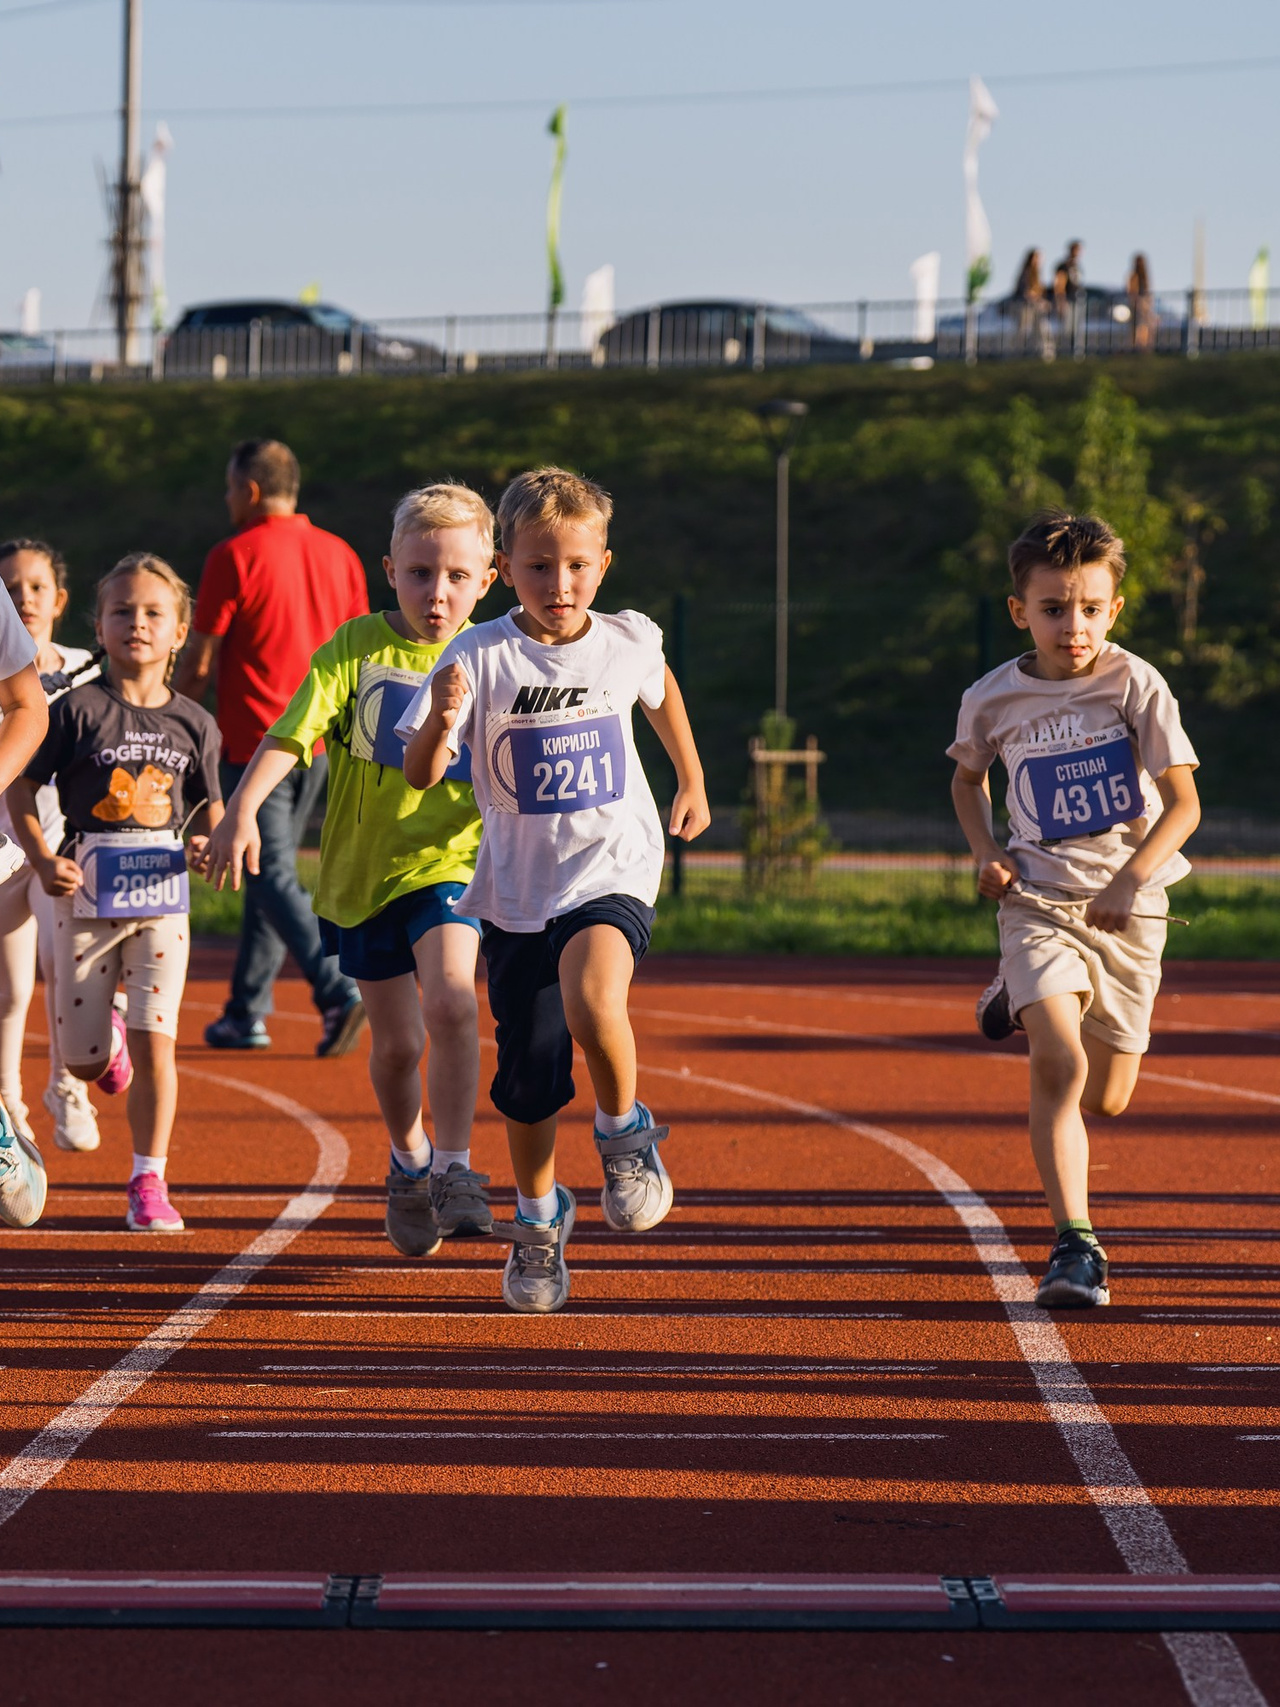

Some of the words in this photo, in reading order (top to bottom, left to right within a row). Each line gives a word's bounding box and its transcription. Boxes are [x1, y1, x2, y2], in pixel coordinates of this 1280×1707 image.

[510, 685, 589, 714] NIKE
[125, 730, 165, 743] HAPPY
[542, 730, 600, 756] КИРИЛЛ
[90, 744, 190, 773] TOGETHER
[1056, 756, 1107, 781] СТЕПАН
[533, 752, 613, 801] 2241
[1052, 773, 1131, 825] 4315
[120, 853, 171, 870] ВАЛЕРИЯ
[112, 873, 181, 908] 2890
